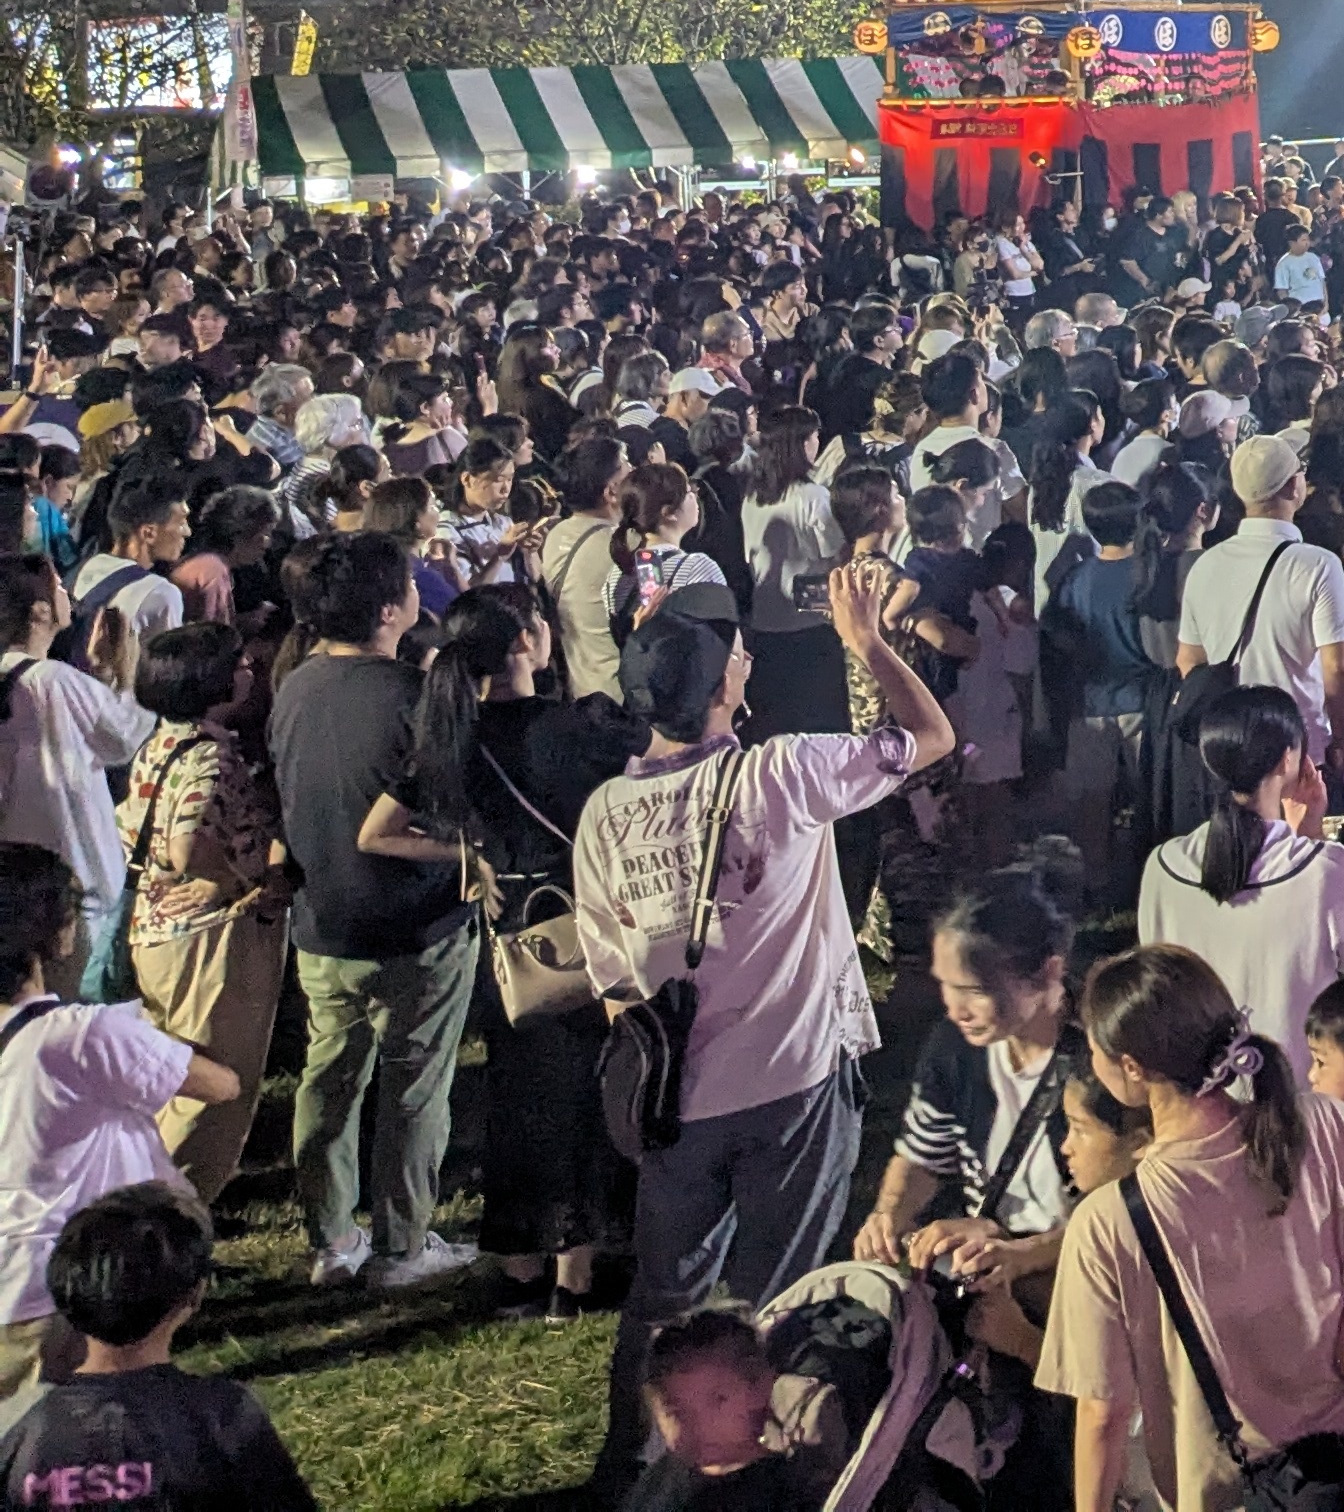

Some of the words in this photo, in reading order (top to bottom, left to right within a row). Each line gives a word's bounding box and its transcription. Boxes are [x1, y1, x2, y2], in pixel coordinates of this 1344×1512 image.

[858, 28, 880, 46] ほ
[1073, 33, 1094, 49] ほ
[618, 871, 675, 903] GREAT
[23, 1462, 152, 1506] MESSI
